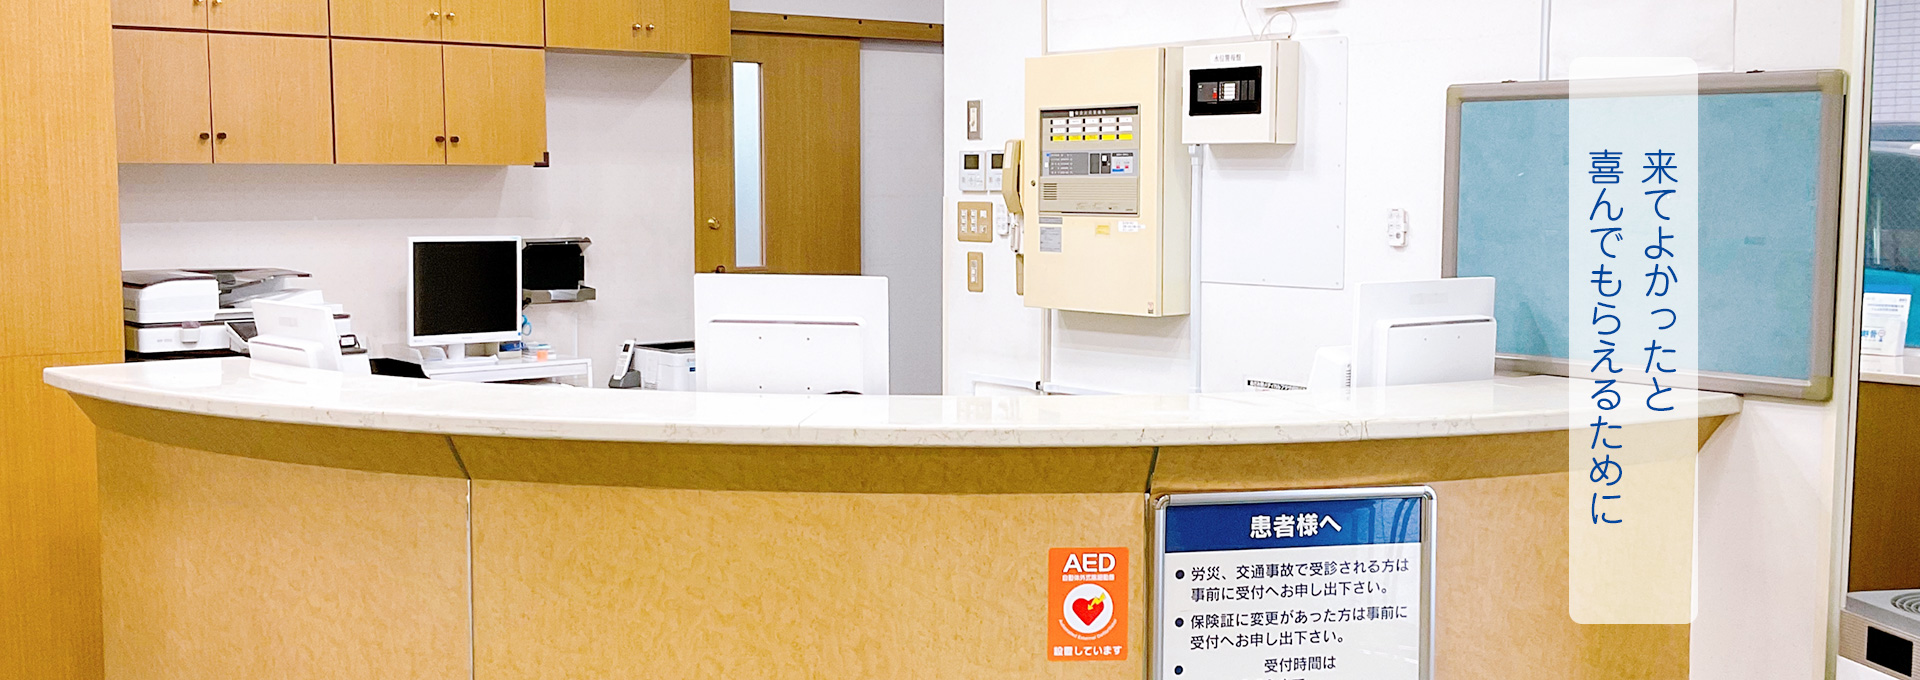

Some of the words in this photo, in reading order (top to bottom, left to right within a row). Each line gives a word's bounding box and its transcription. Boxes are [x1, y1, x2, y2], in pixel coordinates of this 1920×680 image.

[1249, 512, 1343, 539] 患者様へ
[1062, 553, 1116, 573] AED
[1191, 558, 1409, 582] 労災、交通事故で受診される方は
[1191, 580, 1387, 602] 事前に受付へお申し出下さい。
[1190, 605, 1408, 630] 保険証に変更があった方は事前に
[1190, 629, 1344, 651] 受付へお申し出下さい。
[1264, 655, 1337, 674] 受付時間は
